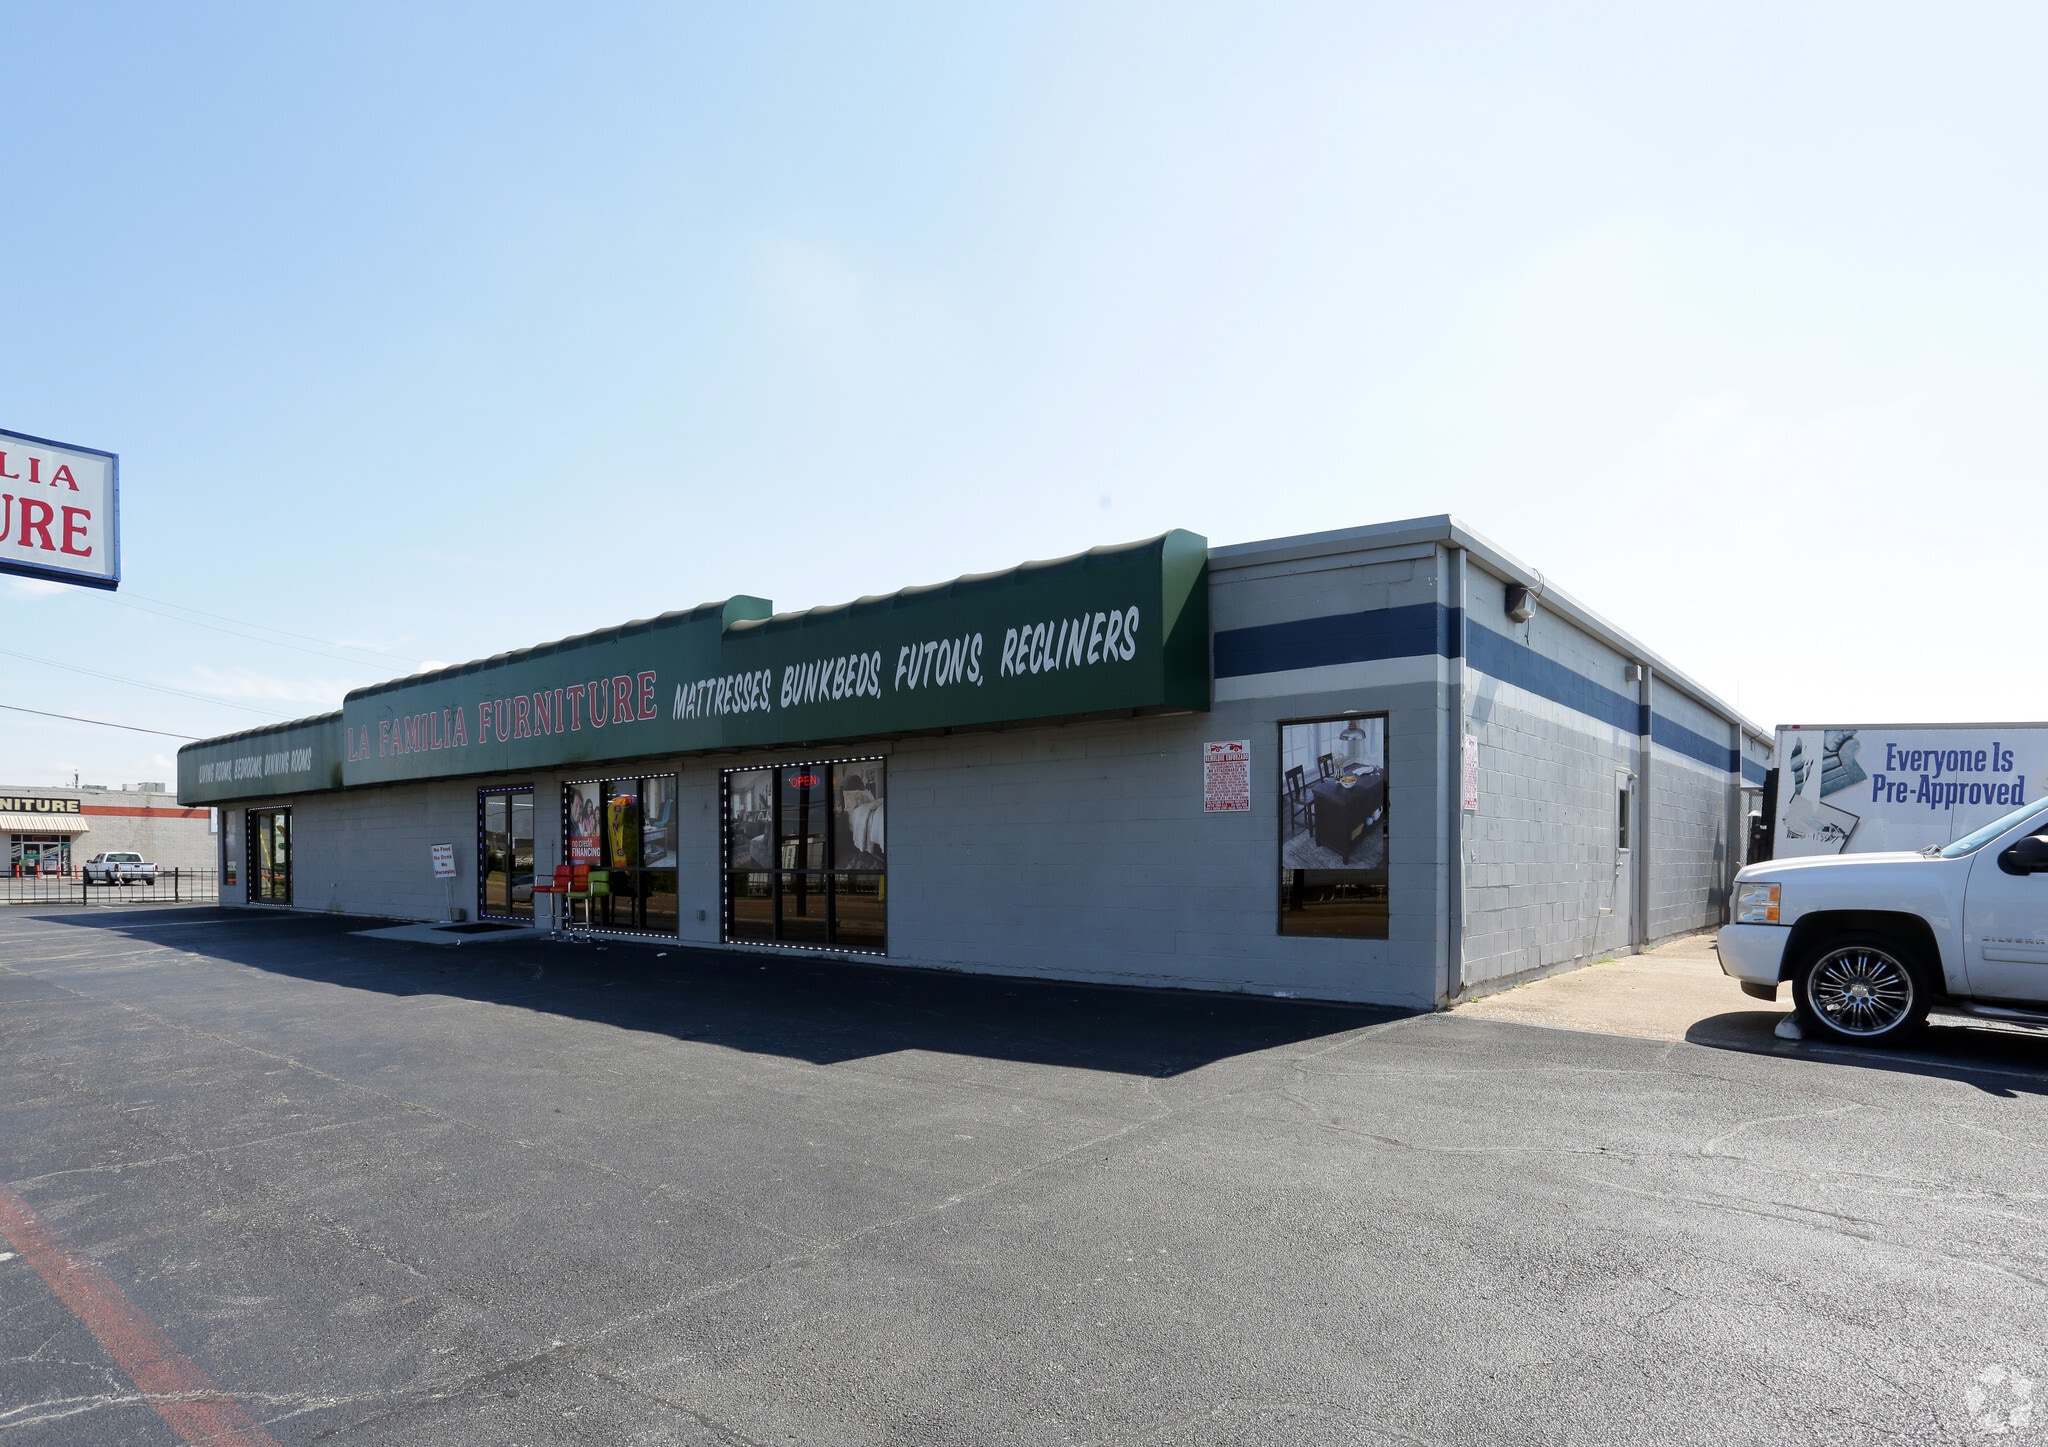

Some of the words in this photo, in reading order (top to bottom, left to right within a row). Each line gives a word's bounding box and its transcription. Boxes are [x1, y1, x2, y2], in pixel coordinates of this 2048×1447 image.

[673, 669, 771, 720] MATTRESSES,
[780, 650, 881, 708] BUNKBEDS,
[895, 633, 984, 692] FUTONS,
[1000, 605, 1140, 677] RECLINERS
[348, 725, 371, 761] LA
[379, 707, 468, 757] FAMILIA
[478, 670, 658, 743] FURNITURE
[1886, 743, 1987, 779] Everyone
[1992, 742, 2014, 772] Is
[791, 775, 817, 788] OPEN
[1872, 774, 2025, 810] Pre-Approved
[0, 799, 79, 812] NITURE
[572, 848, 600, 857] FINANCING
[579, 838, 592, 847] credit
